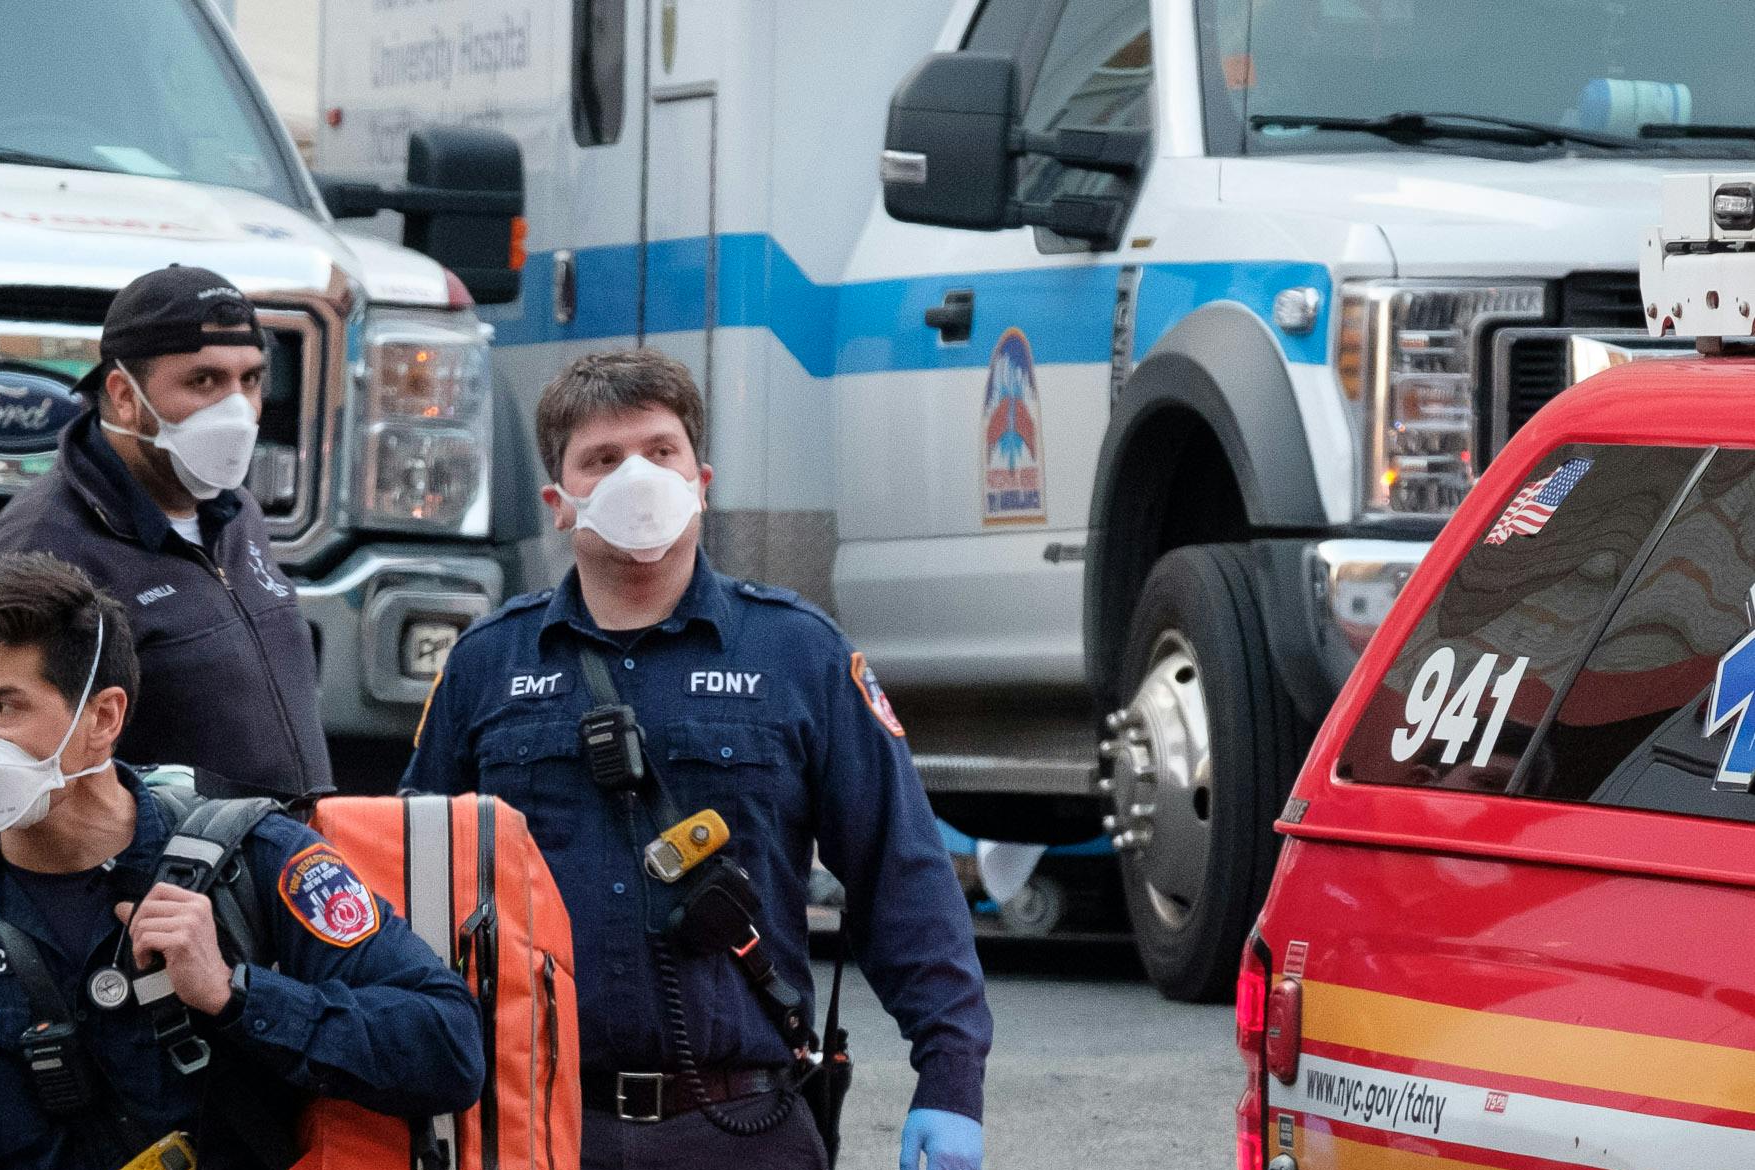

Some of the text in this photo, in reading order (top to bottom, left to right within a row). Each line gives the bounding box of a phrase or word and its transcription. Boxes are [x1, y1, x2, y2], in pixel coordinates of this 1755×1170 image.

[509, 672, 563, 697] EMT
[690, 671, 762, 695] FDNY
[1390, 646, 1531, 768] 941
[303, 865, 322, 881] CITY
[303, 876, 322, 893] NEW
[1307, 1069, 1447, 1134] www.nyc.gov/fdny
